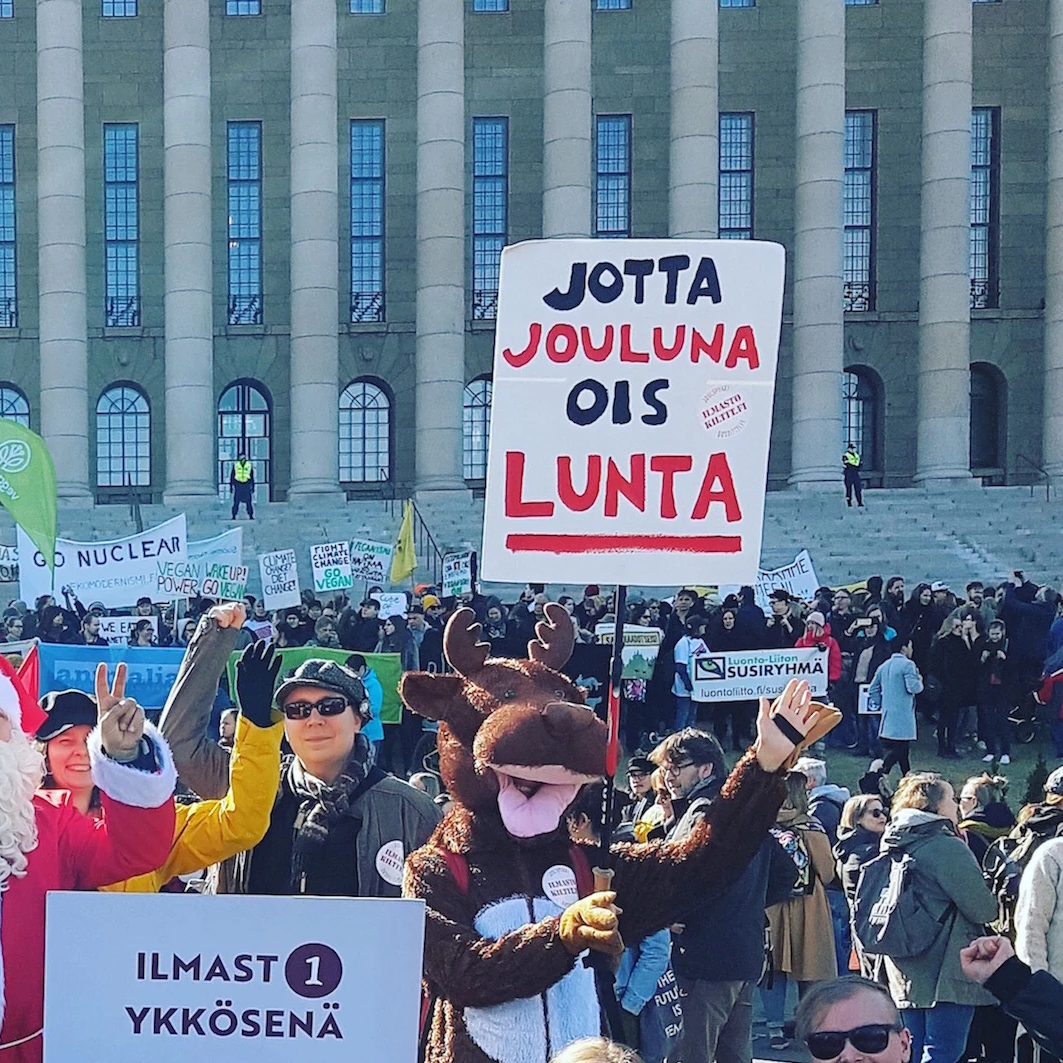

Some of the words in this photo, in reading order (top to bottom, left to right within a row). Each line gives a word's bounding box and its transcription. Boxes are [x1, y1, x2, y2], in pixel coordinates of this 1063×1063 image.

[543, 255, 722, 311] JOTTA
[502, 323, 760, 370] JOULUNA
[566, 378, 670, 426] OIS
[505, 451, 742, 523] LUNTA
[33, 551, 65, 568] GO
[77, 536, 181, 567] NUCLEAR
[157, 561, 200, 578] VEGAN
[324, 568, 341, 578] GO
[157, 576, 198, 595] POWER
[202, 579, 219, 595] GO
[316, 575, 352, 590] VEGAN
[101, 622, 115, 633] WE
[727, 658, 824, 678] SUSIRYHMÄ
[728, 655, 798, 665] Luonto-Liiton
[657, 970, 676, 988] THE
[672, 1003, 682, 1017] IS
[125, 999, 344, 1040] YKKÖSENÄ
